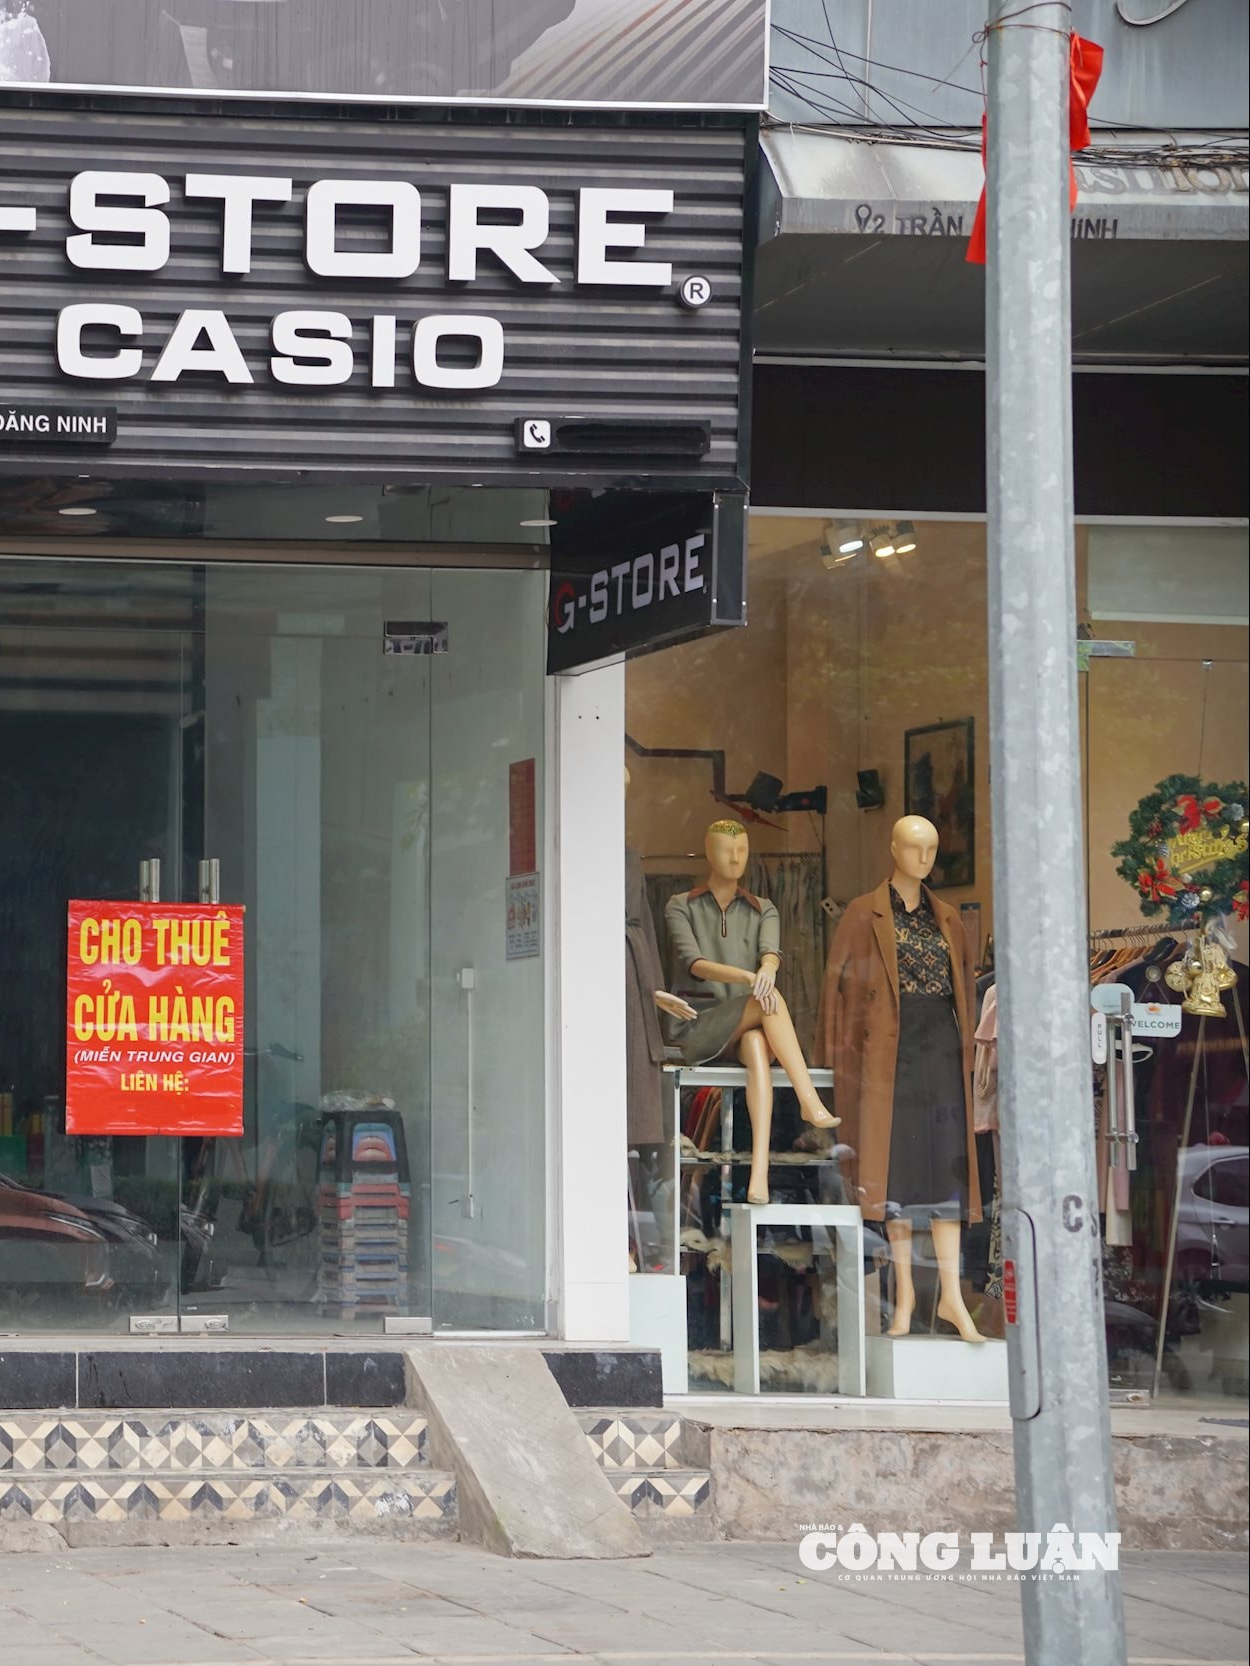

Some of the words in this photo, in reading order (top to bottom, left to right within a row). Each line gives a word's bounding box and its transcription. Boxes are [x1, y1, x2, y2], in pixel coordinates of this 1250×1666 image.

[1070, 219, 1118, 239] INH
[56, 303, 505, 390] CASIO
[57, 415, 107, 433] NINH
[554, 533, 705, 634] G-STORE
[79, 917, 143, 966] CHO
[153, 911, 231, 966] THUÊ
[74, 979, 138, 1042] CỬA
[149, 986, 235, 1043] HÀNG
[127, 1051, 184, 1063] TRUNG
[189, 1052, 235, 1066] GIAN)
[121, 1070, 157, 1092] LIÊN
[162, 1071, 189, 1095] HỆ:
